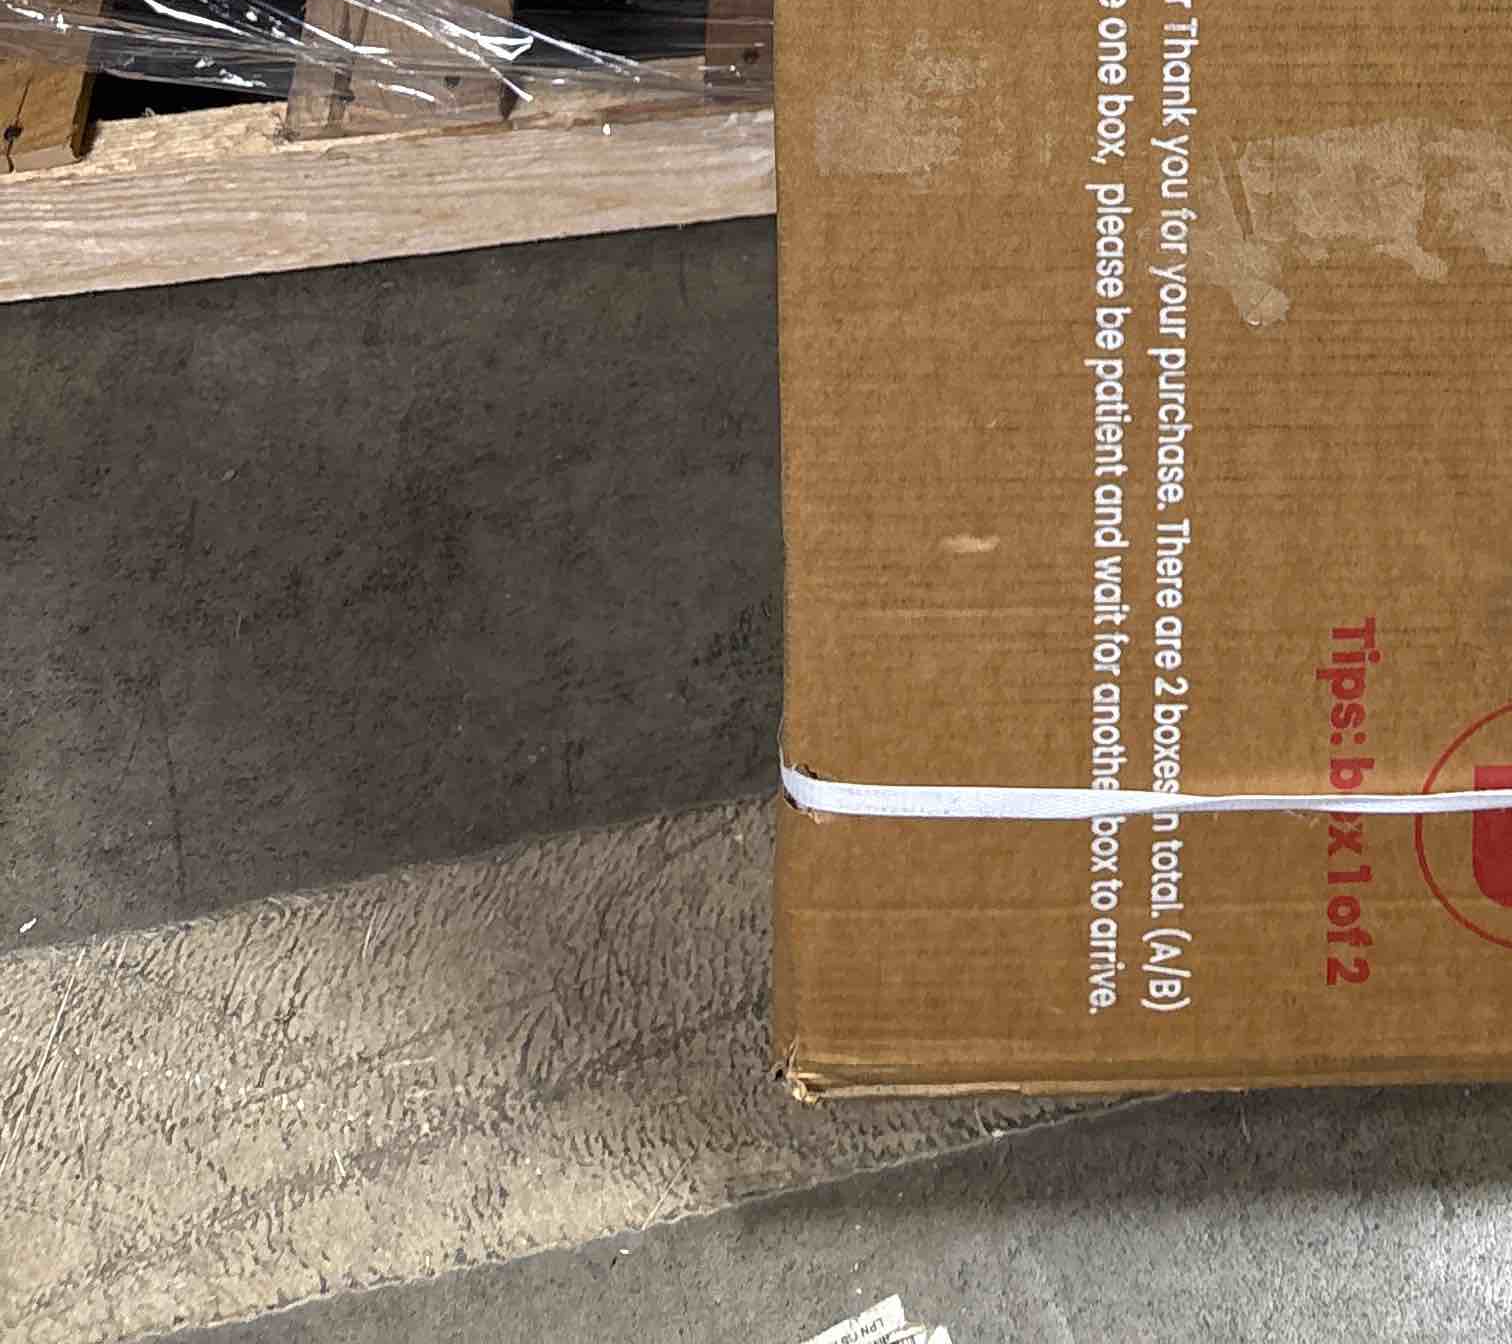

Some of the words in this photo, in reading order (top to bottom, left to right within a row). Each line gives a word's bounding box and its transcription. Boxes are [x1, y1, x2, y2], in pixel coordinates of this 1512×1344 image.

[1097, 16, 1128, 87] one
[1162, 17, 1199, 127] Thank
[1090, 93, 1135, 166] box,
[1150, 135, 1189, 200] you
[1084, 183, 1134, 300] please
[1160, 206, 1198, 255] for
[1095, 306, 1133, 351] be
[1148, 262, 1187, 340] your
[1083, 359, 1133, 477] patient
[1146, 347, 1193, 511] purchase.
[1094, 483, 1130, 548] and
[1093, 555, 1132, 626] wait
[1156, 518, 1191, 609] There
[1092, 632, 1131, 677] for
[1154, 615, 1184, 671] are
[1154, 676, 1189, 697] 2
[1316, 616, 1382, 745] Tips:
[1091, 683, 1129, 791] anothe
[1152, 703, 1189, 793] boxes
[1090, 813, 1127, 873] box
[1150, 838, 1184, 919] total.
[1327, 864, 1373, 885] 1
[1089, 878, 1124, 913] to
[1326, 895, 1374, 947] of
[1088, 917, 1126, 1015] arrive.
[1140, 927, 1192, 1012] (A/B)
[1326, 957, 1371, 986] 2
